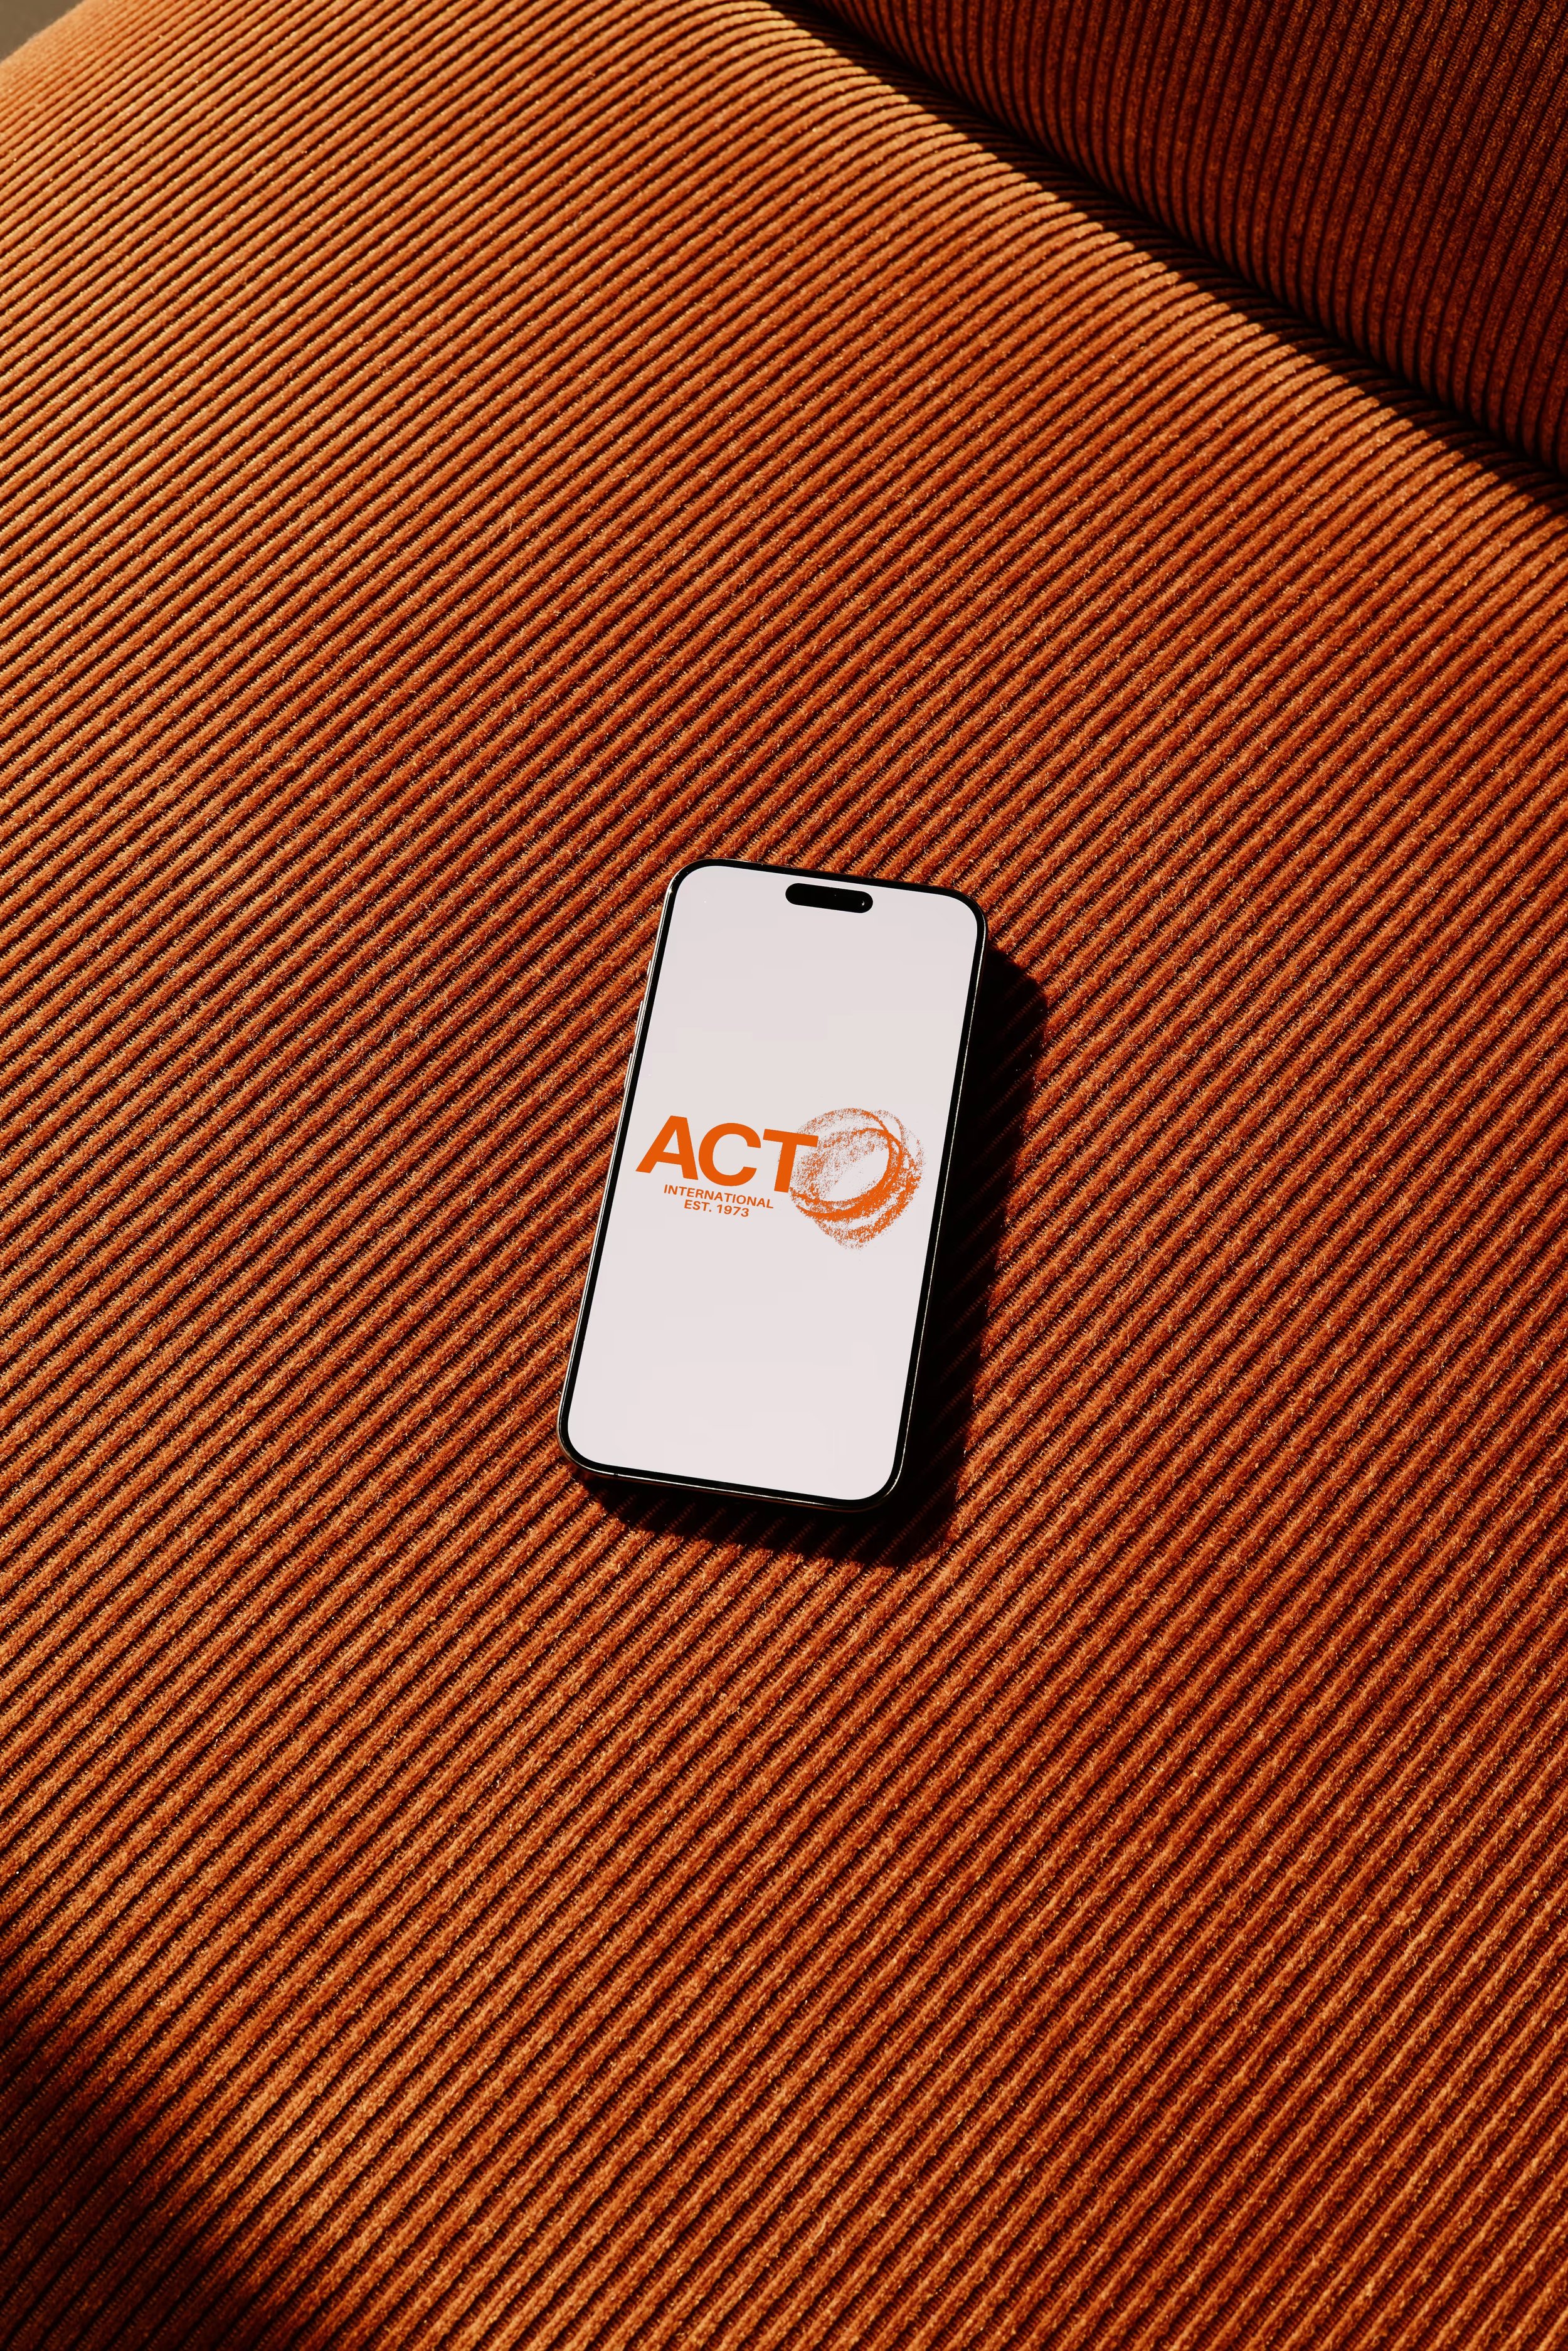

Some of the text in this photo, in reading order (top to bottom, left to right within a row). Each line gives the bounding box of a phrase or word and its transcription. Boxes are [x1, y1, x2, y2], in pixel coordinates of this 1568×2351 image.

[664, 1184, 773, 1209] INTERNATIONAL
[684, 1199, 749, 1218] EST. 1973
